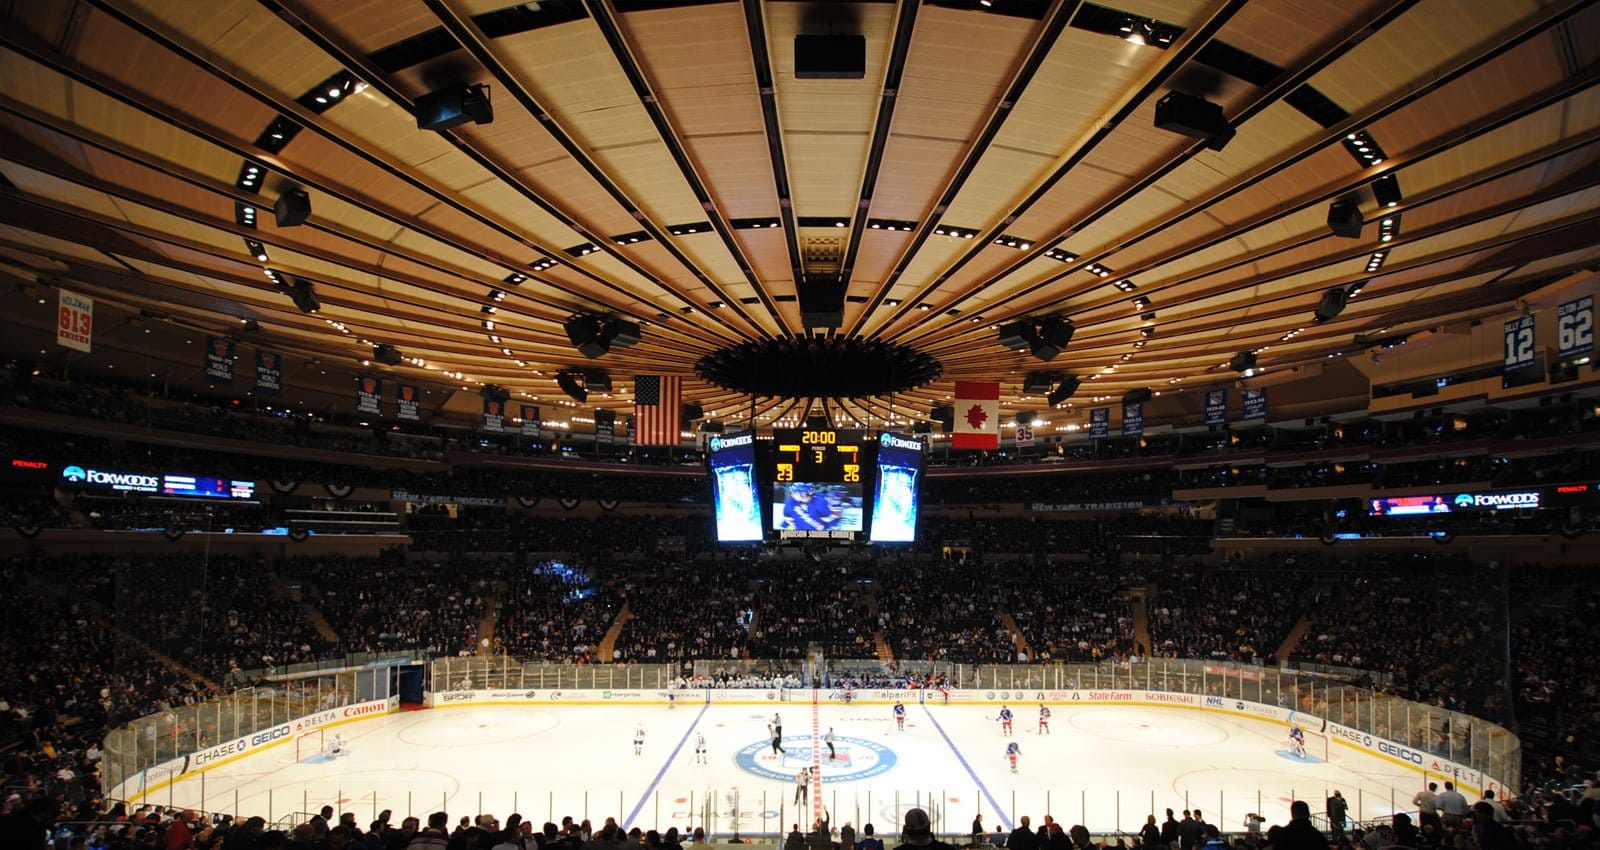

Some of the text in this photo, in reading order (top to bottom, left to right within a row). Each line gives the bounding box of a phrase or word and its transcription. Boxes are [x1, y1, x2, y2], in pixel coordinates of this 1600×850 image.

[60, 306, 91, 335] 613
[1505, 322, 1519, 333] BILLY
[1559, 309, 1593, 350] 62
[1505, 328, 1533, 365] 12
[802, 431, 836, 444] 20:00
[1017, 428, 1033, 441] 35
[720, 435, 752, 448] FOXWOODS
[891, 436, 922, 450] FOXWOODS
[815, 451, 823, 463] 3
[12, 459, 48, 469] PENALTY
[86, 470, 159, 487] FOXWOODS
[777, 469, 793, 481] 23
[843, 470, 859, 482] 26
[1557, 485, 1587, 493] PENALTY
[1474, 493, 1540, 507] FOXWOODS
[780, 530, 855, 540] MADISON SQUARE GARDEN
[880, 690, 917, 700] alpariFX
[1144, 693, 1193, 704] SOBIESKI
[1206, 696, 1224, 706] NHL
[343, 703, 385, 718] Canon
[305, 712, 337, 728] DELTA
[251, 725, 291, 747] GEICO
[1329, 725, 1362, 744] CHASE
[195, 743, 235, 766] CHASE
[1378, 740, 1423, 765] GEICO
